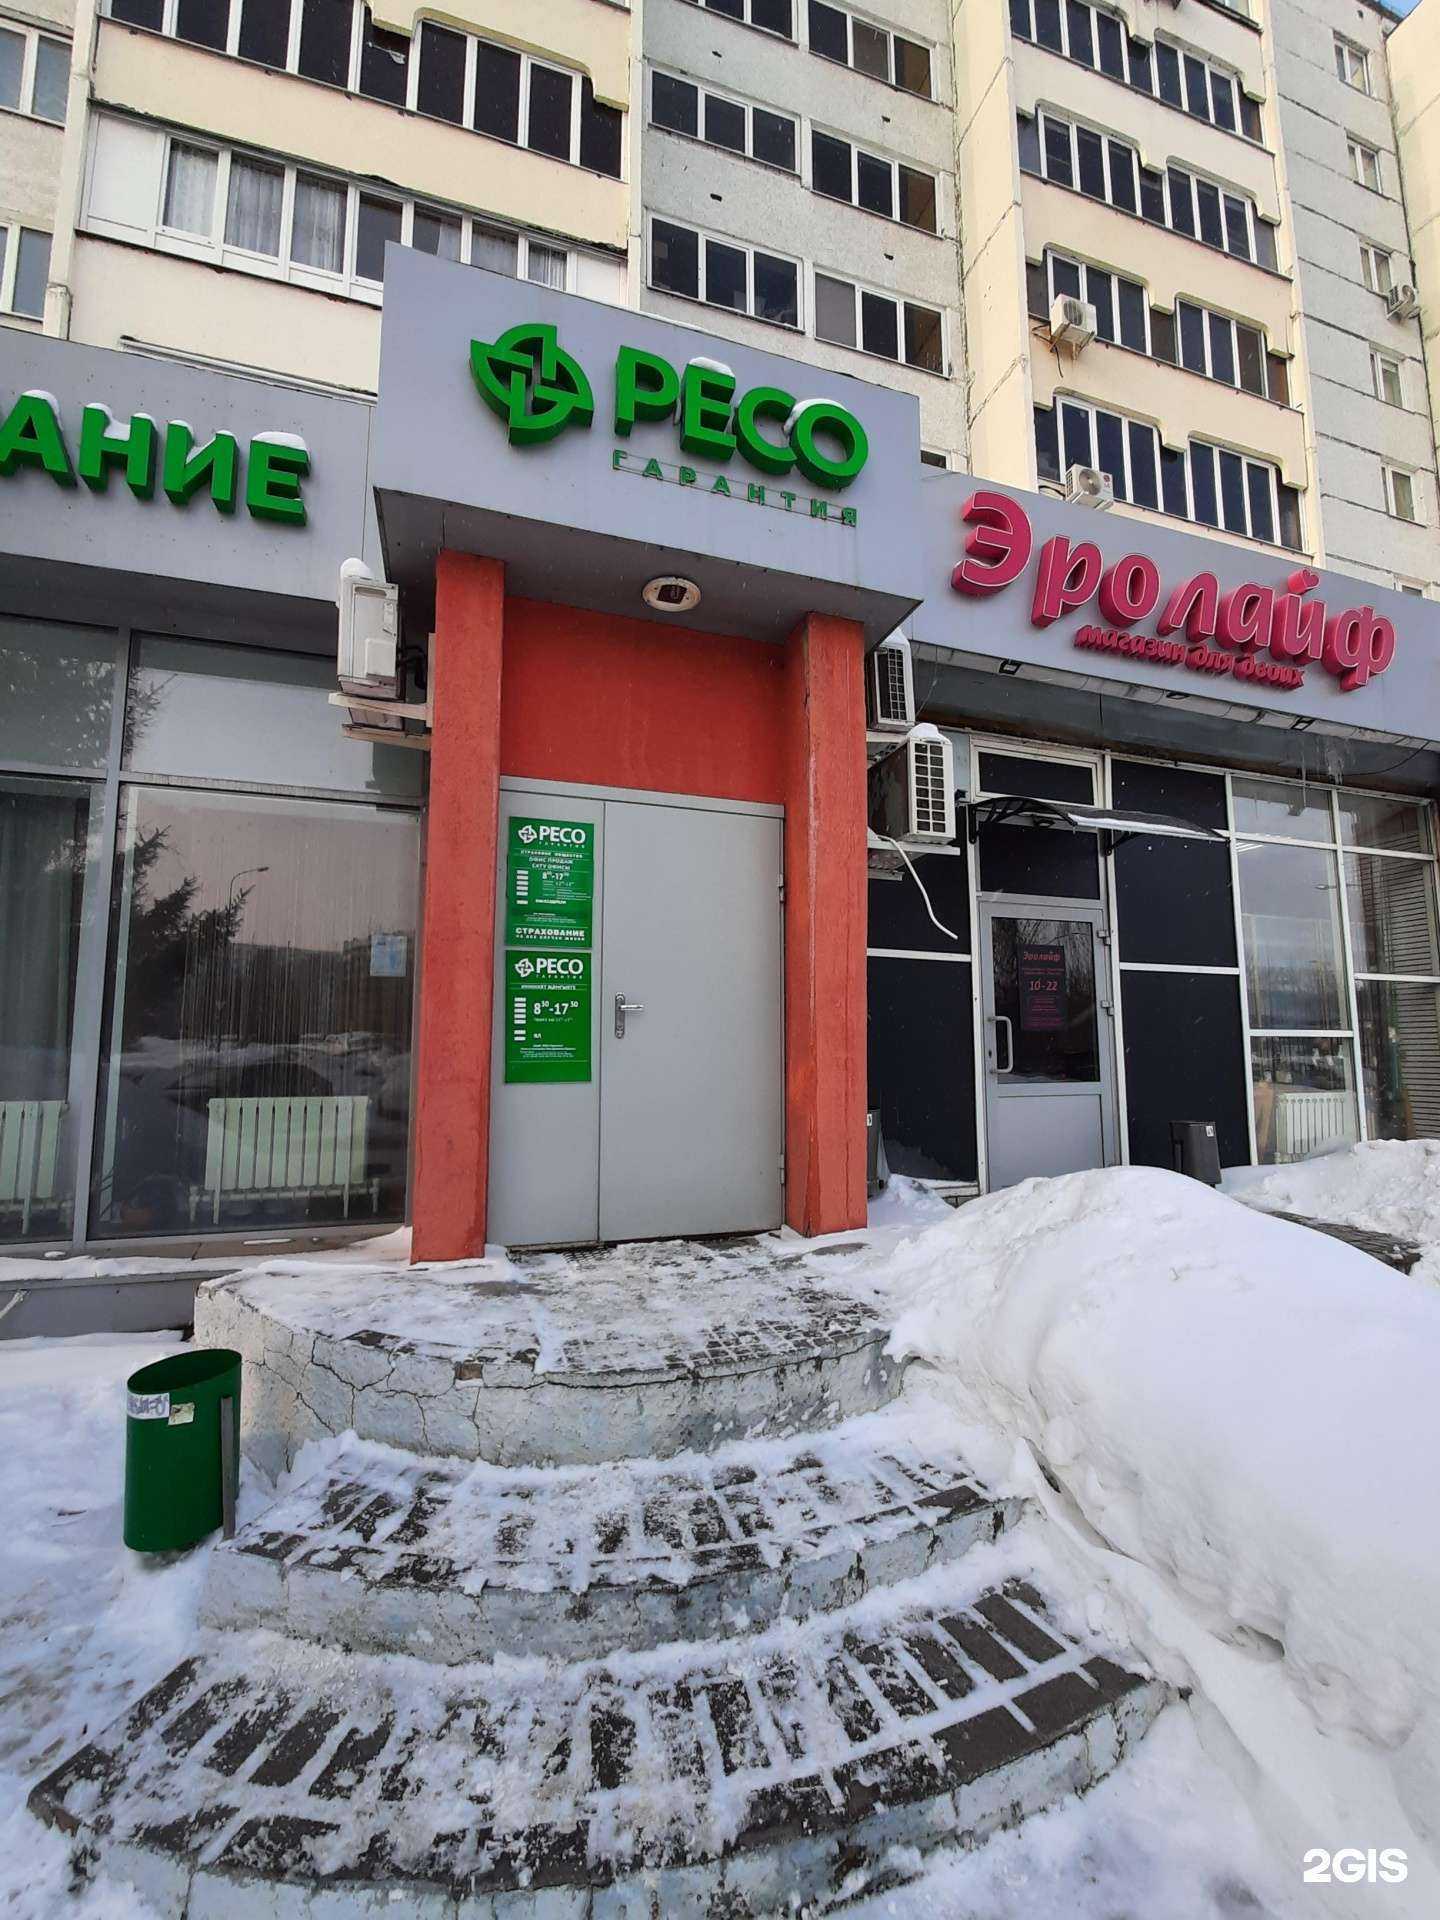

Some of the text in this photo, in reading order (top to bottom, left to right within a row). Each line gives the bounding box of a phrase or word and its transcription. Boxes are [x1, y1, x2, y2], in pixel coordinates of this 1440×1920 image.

[614, 345, 869, 490] РЕСО
[612, 448, 857, 527] ГАРАНТИЯ
[1073, 625, 1304, 690] магазин для двоих
[539, 825, 586, 844] РЕСО
[515, 927, 585, 937] СТРАХОВАНИЕ
[536, 958, 584, 975] РЕСО
